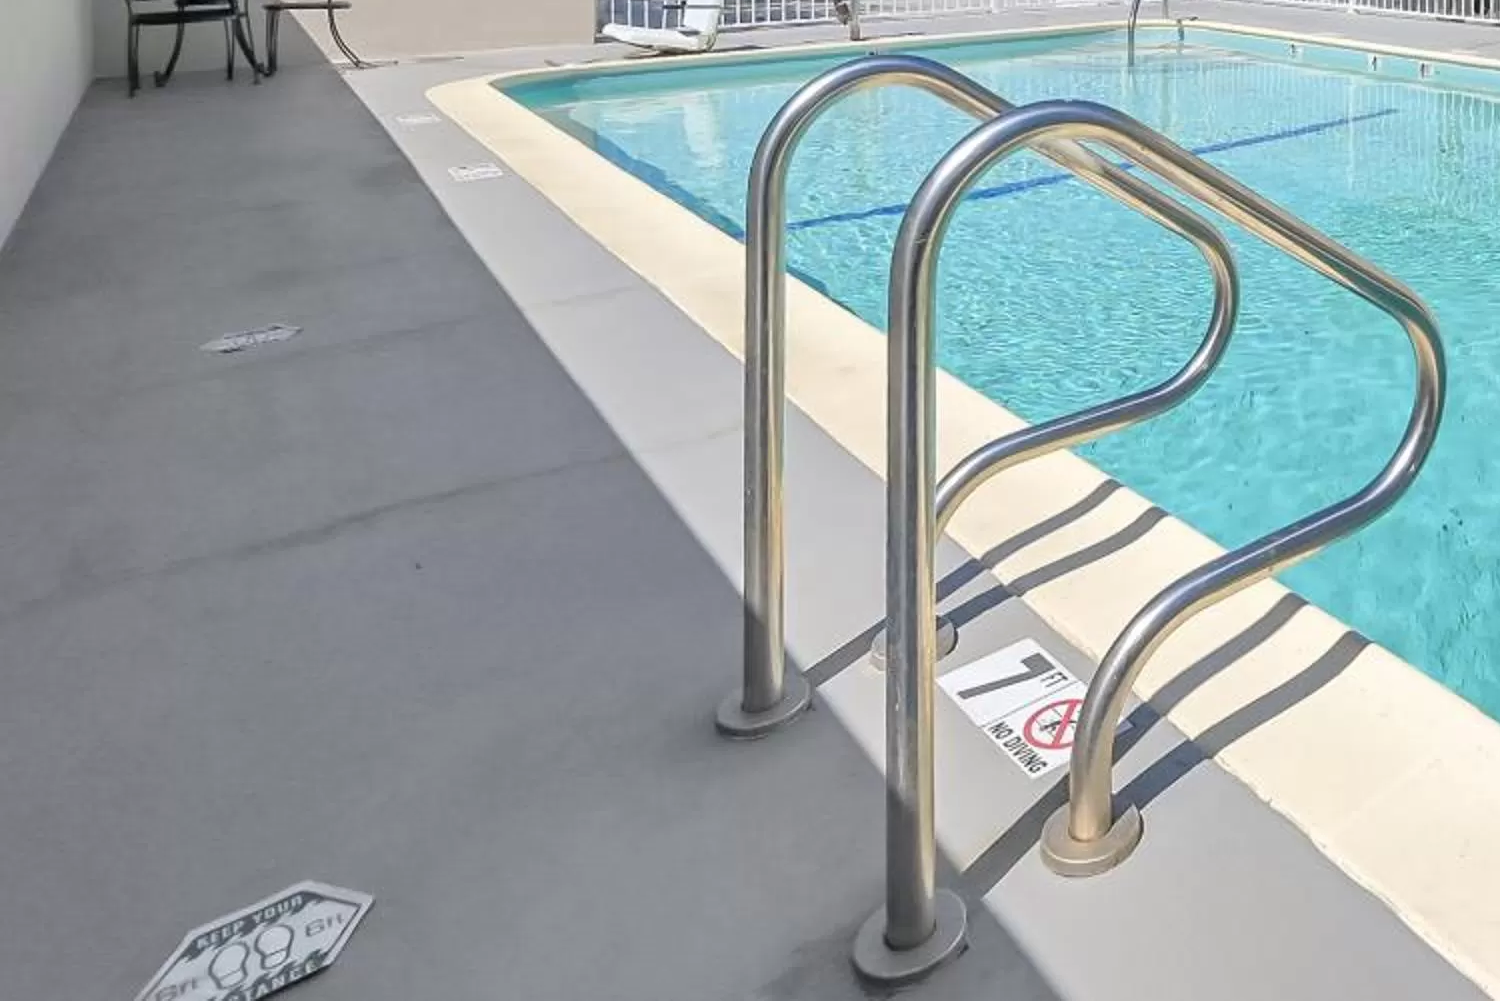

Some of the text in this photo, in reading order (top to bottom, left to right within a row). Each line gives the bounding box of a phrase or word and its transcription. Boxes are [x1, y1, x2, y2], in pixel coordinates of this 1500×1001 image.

[956, 652, 1056, 700] 7
[1040, 671, 1068, 688] FT
[988, 721, 1048, 774] NO DIVING
[196, 896, 304, 950] KEEP YOUR
